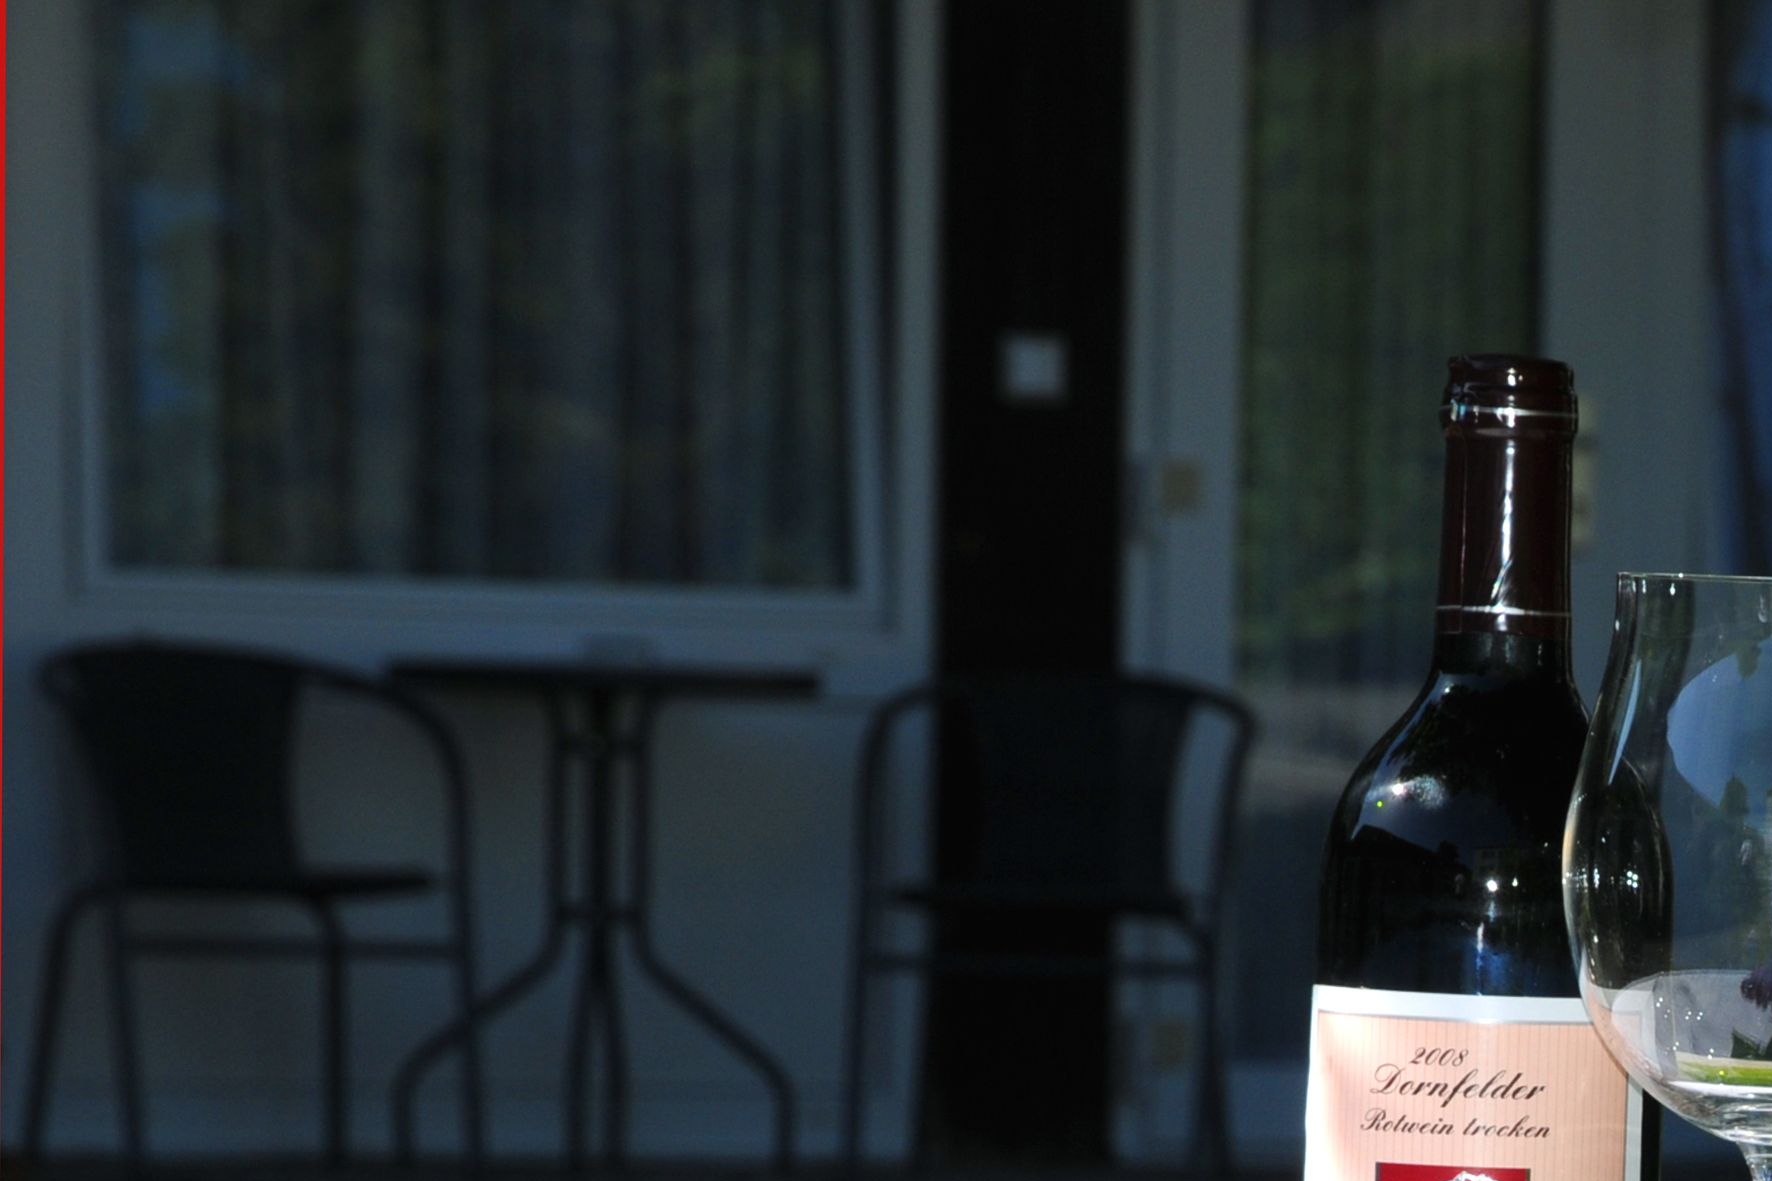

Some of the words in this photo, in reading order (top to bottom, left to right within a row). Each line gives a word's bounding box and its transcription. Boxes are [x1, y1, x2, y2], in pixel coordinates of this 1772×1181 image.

[1409, 1047, 1470, 1068] 2008
[1369, 1063, 1548, 1108] Dornfelder
[1360, 1107, 1456, 1136] Rotwein
[1462, 1115, 1552, 1140] trocken
